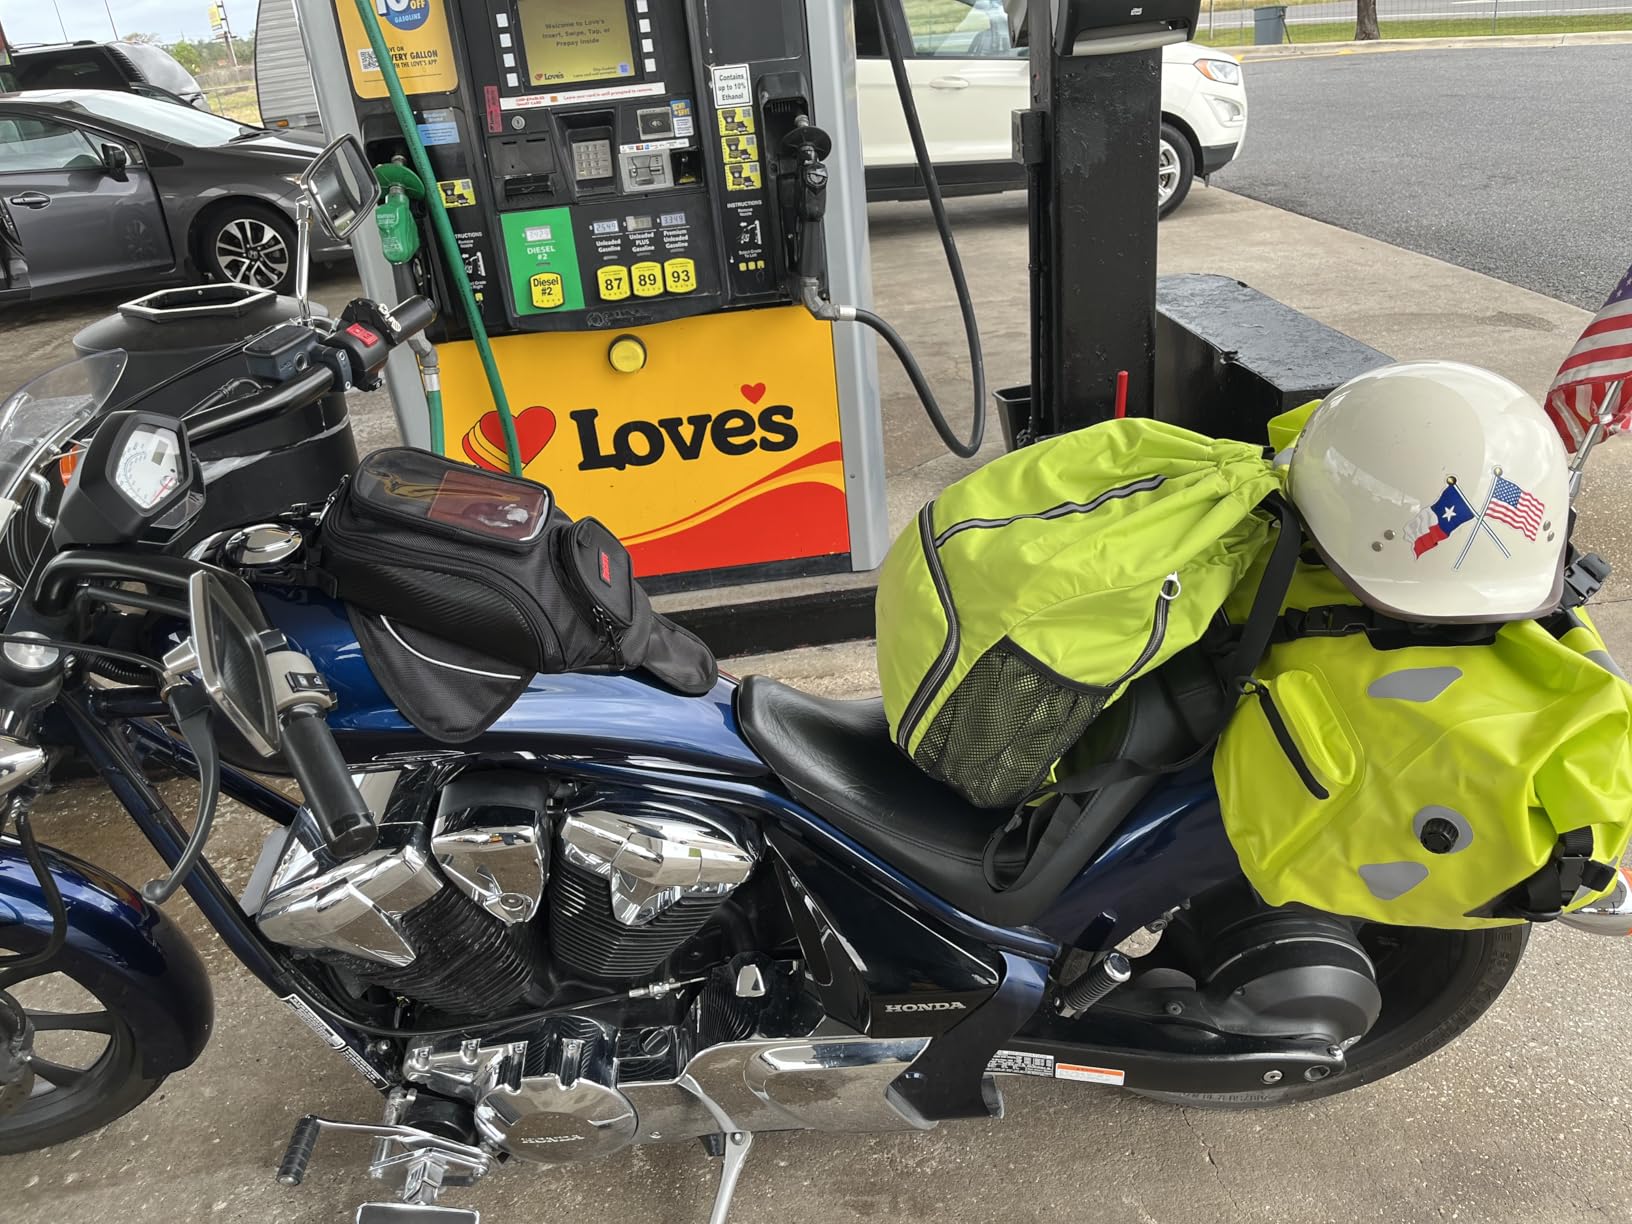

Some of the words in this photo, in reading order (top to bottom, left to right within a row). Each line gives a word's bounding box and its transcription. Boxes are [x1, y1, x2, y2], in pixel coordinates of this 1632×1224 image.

[395, 13, 421, 23] GASOLINE
[410, 50, 438, 60] GALLON
[720, 73, 744, 81] Contains
[722, 92, 744, 100] Ethanol
[727, 200, 762, 208] INSTRUCTIONS
[455, 231, 483, 239] TRUCTIONS
[629, 232, 654, 240] Unleaded
[527, 245, 555, 254] DIESEL
[665, 241, 688, 249] Gasoline
[639, 273, 656, 286] 89
[671, 270, 690, 283] 93
[533, 276, 559, 287] Diesel
[605, 278, 622, 291] 87
[541, 287, 553, 296] #2
[885, 1001, 966, 1013] HONDA
[521, 1135, 585, 1144] HONDA
